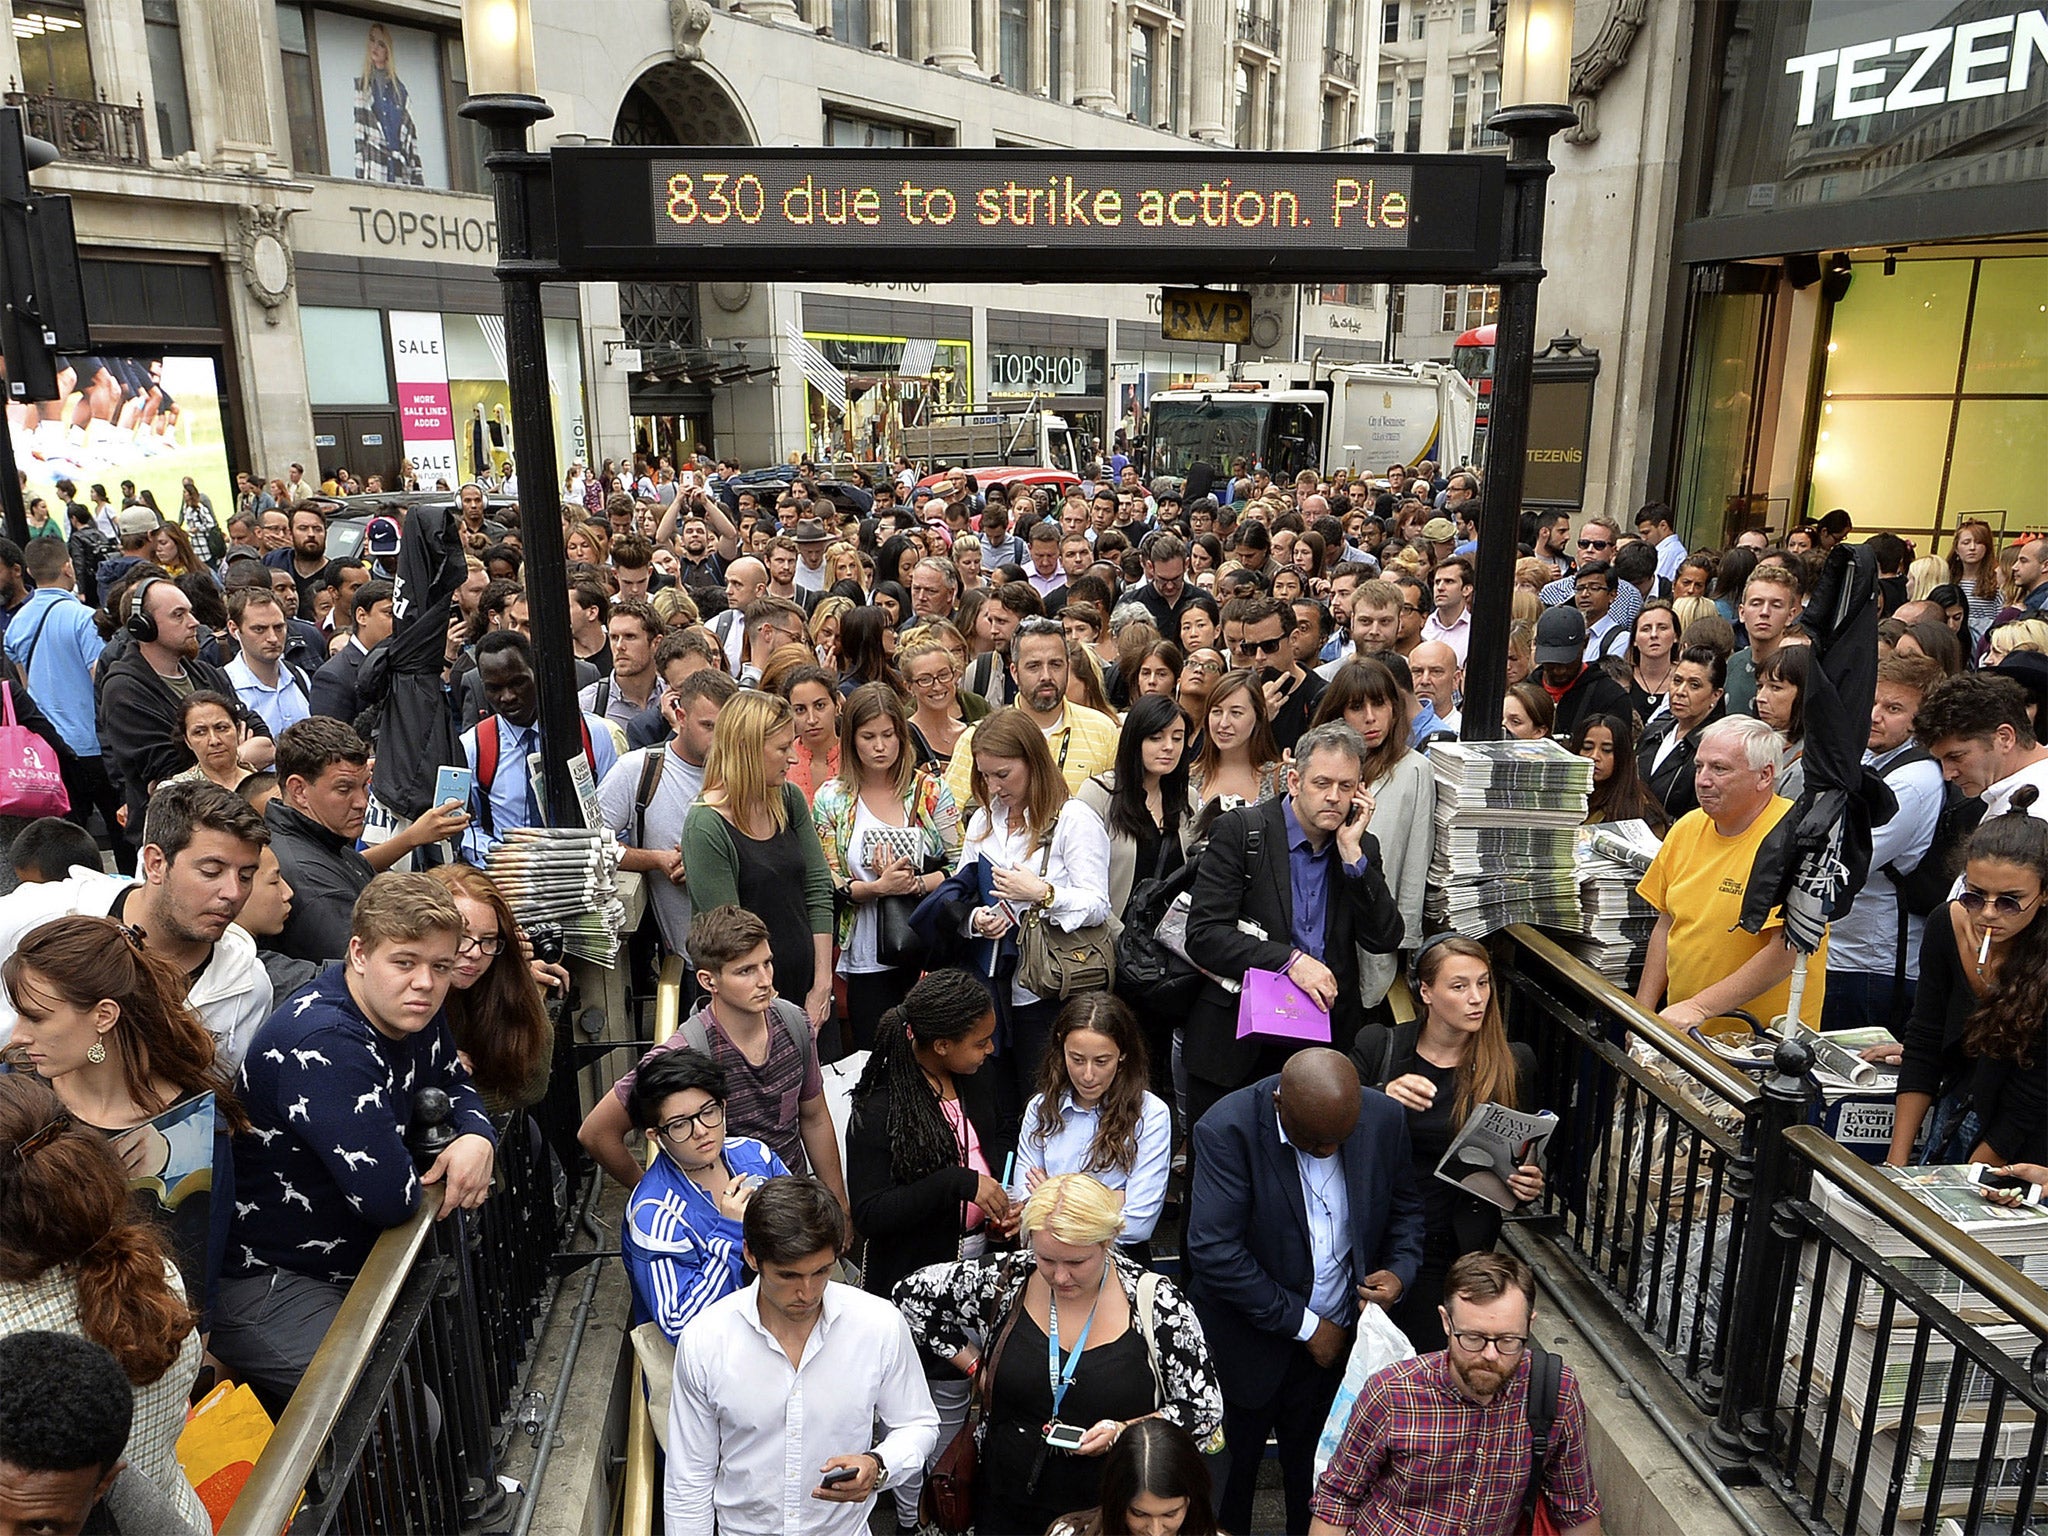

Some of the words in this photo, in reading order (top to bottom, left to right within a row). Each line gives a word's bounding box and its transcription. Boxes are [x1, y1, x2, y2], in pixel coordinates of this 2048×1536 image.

[666, 174, 764, 224] 830
[781, 175, 879, 224] due
[895, 181, 957, 224] to
[977, 176, 1121, 225] strike
[1135, 178, 1310, 227] action.
[1332, 179, 1408, 228] Ple
[1172, 301, 1243, 333] RVP
[399, 340, 439, 354] SALE
[994, 354, 1083, 385] TOPSHOP
[413, 395, 435, 404] MORE
[404, 407, 424, 416] SALE
[425, 407, 448, 416] LINES
[414, 418, 440, 427] ADDED
[411, 456, 451, 470] SALE
[1489, 1108, 1537, 1134] BUNNY
[1845, 1111, 1894, 1126] Eveni
[1484, 1119, 1524, 1141] TALES
[1050, 1305, 1058, 1336] LUSH
